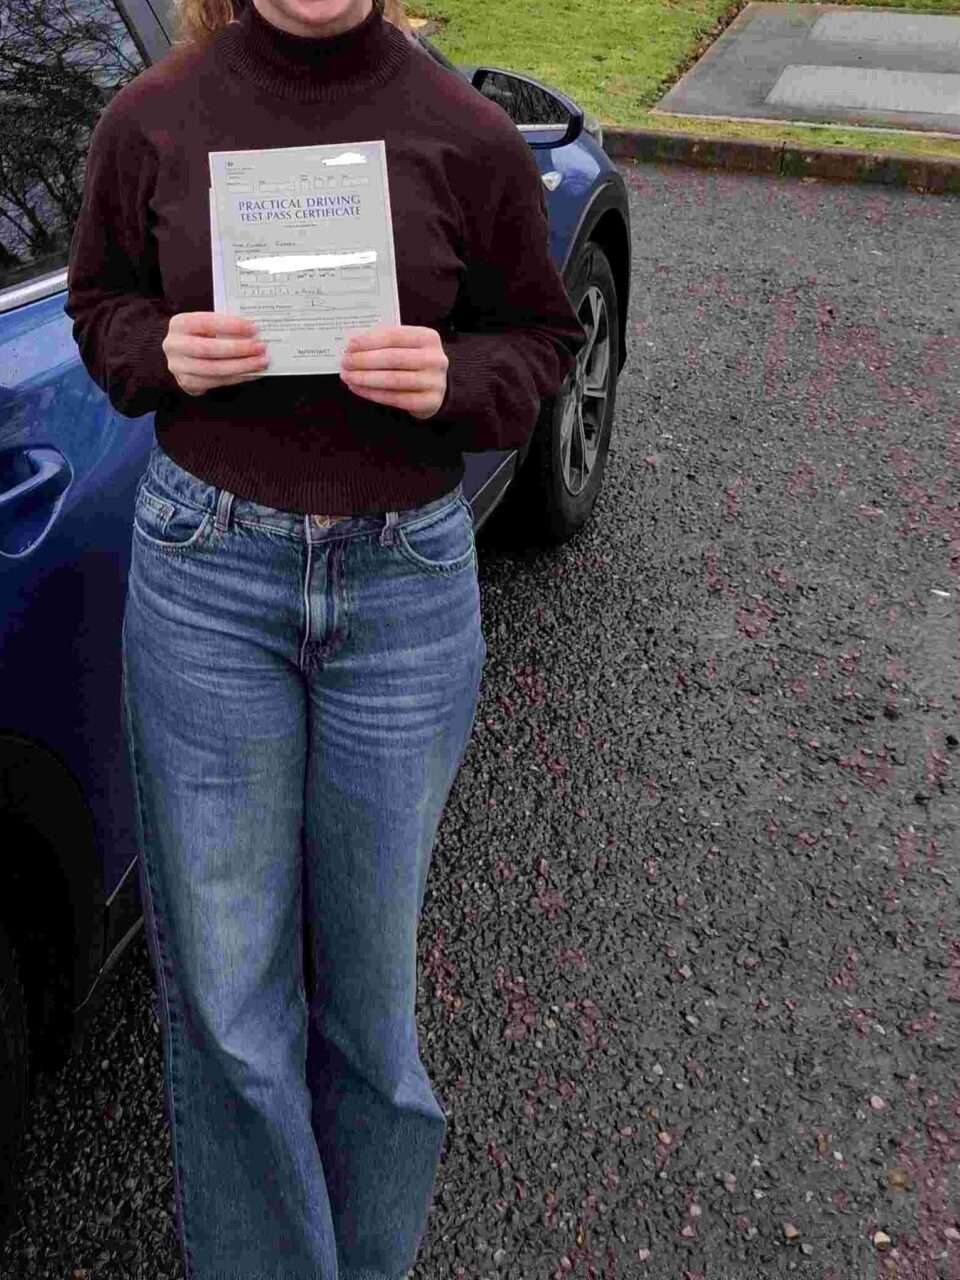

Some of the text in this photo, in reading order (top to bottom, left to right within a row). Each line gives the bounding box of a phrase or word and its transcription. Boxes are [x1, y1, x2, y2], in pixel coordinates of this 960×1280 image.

[239, 194, 361, 211] PRACTICAL DRIVING
[240, 205, 361, 222] TEST PASS CERTIFICATE
